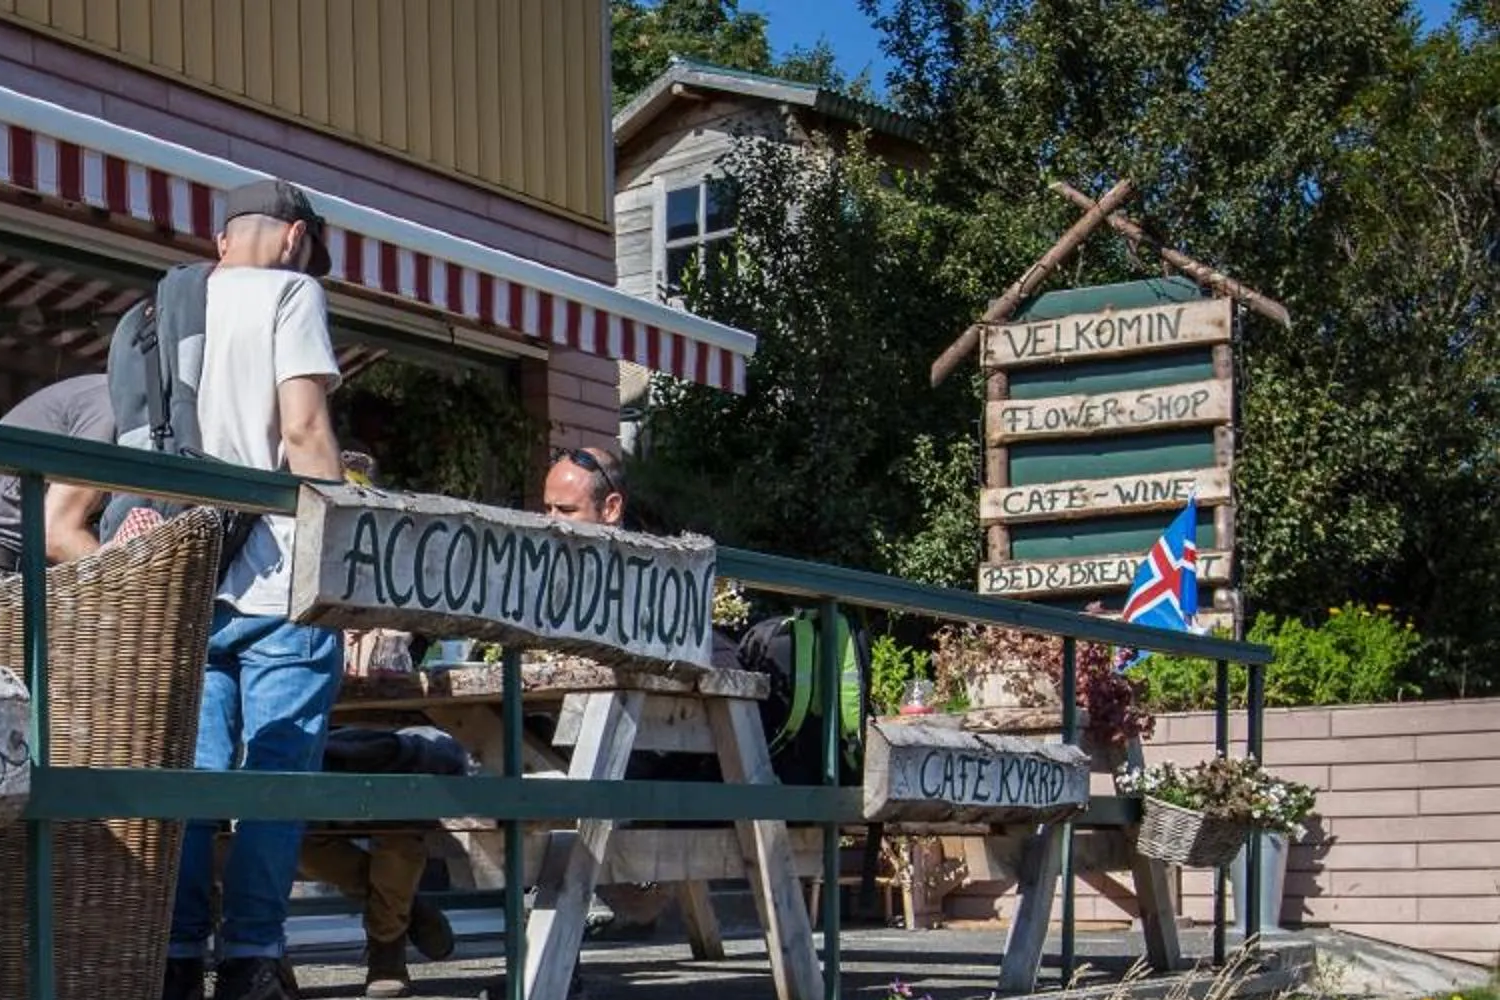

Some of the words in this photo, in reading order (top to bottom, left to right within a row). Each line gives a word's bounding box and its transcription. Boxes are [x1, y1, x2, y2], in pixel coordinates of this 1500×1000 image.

[1003, 307, 1185, 359] VELKOMIN
[1001, 398, 1122, 432] FLOWER
[1129, 390, 1209, 423] SHOP
[1113, 477, 1197, 504] WINE
[341, 511, 717, 648] ACCOMMODATION
[983, 555, 1222, 592] BED&BREAT
